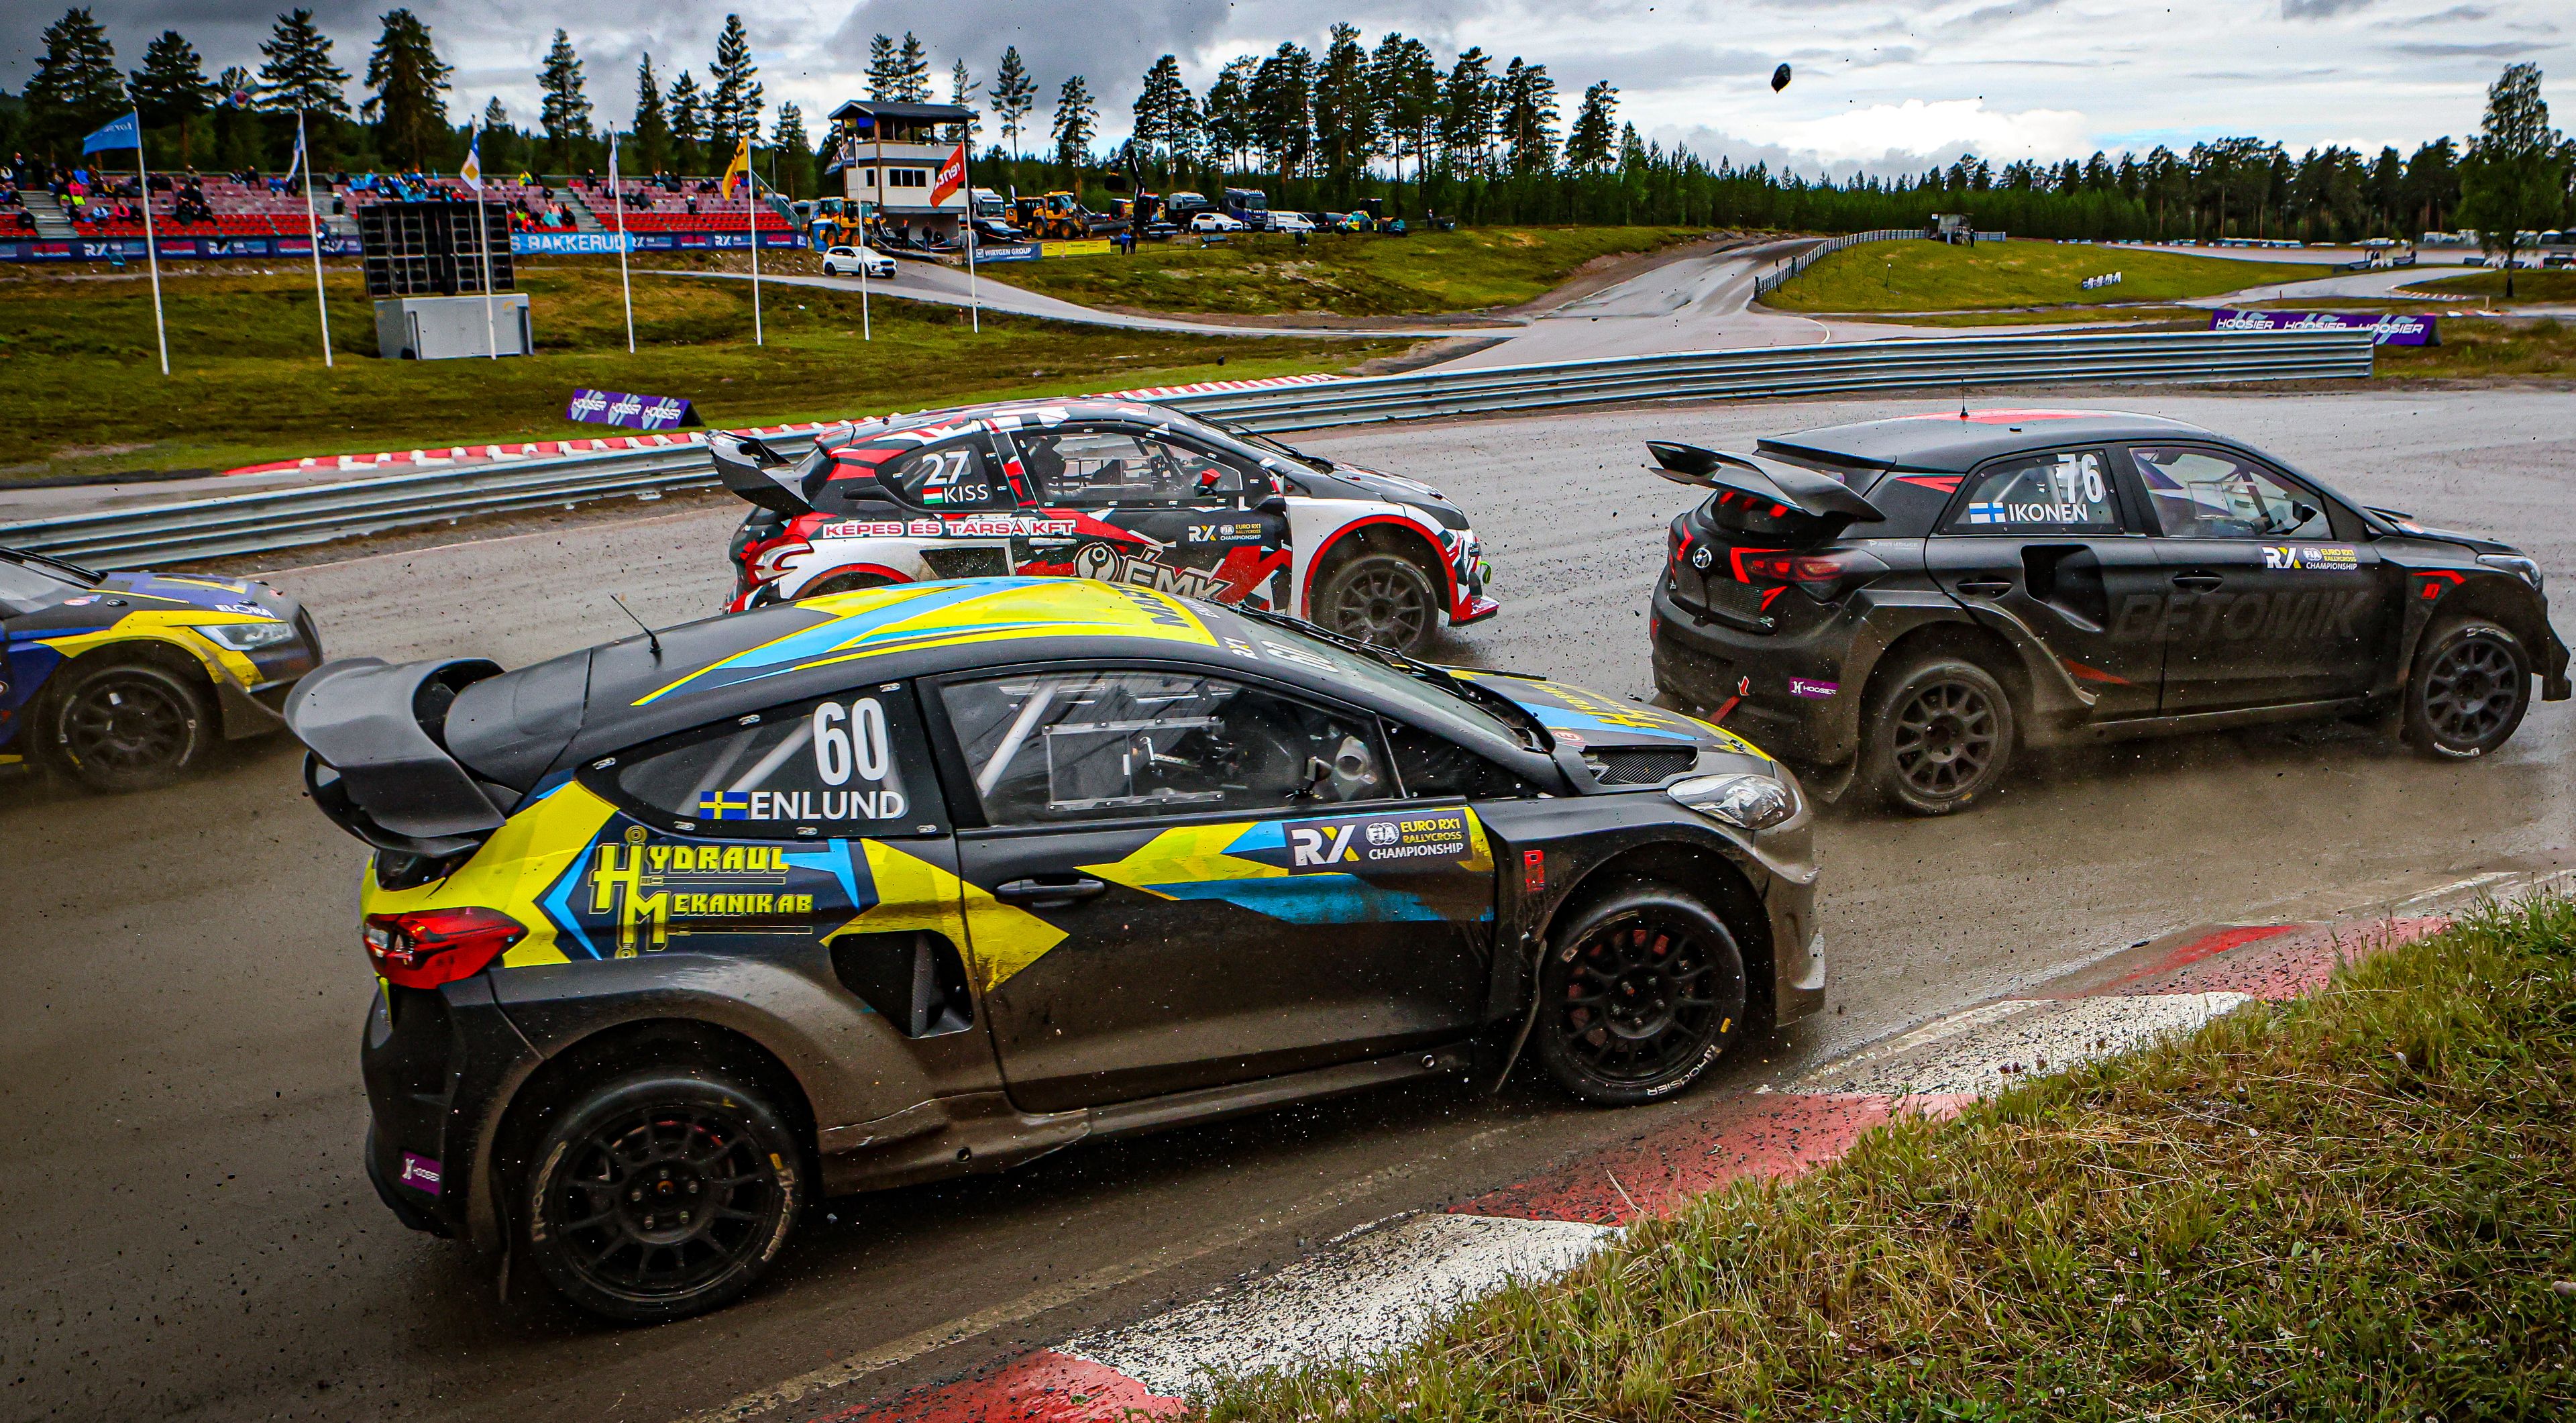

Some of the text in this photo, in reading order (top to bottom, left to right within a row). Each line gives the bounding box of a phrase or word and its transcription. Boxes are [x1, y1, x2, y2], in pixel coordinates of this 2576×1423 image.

[528, 234, 626, 251] BAKKERUD
[985, 247, 1032, 256] WIRTGEN GROUP
[2215, 318, 2275, 329] HOOSIER
[922, 450, 970, 486] 27
[2057, 454, 2103, 503] 76
[944, 483, 988, 503] KISS
[2008, 503, 2089, 522] IKONEN
[825, 520, 1073, 536] KÉPES ÉS TÁRSA KFT
[1188, 525, 1216, 542] RX
[2261, 547, 2301, 569] RX
[2306, 562, 2357, 570] CHAMPIONSHIP
[2108, 590, 2372, 642] BETOMIK
[813, 697, 890, 786] 60
[751, 790, 906, 820] ENLUND
[1399, 818, 1461, 833] EURO RX1
[1291, 824, 1360, 866] RX
[1402, 831, 1462, 844] RALLYCROSS
[1368, 842, 1464, 861] CHAMPIONSHIP
[775, 893, 814, 914] AB
